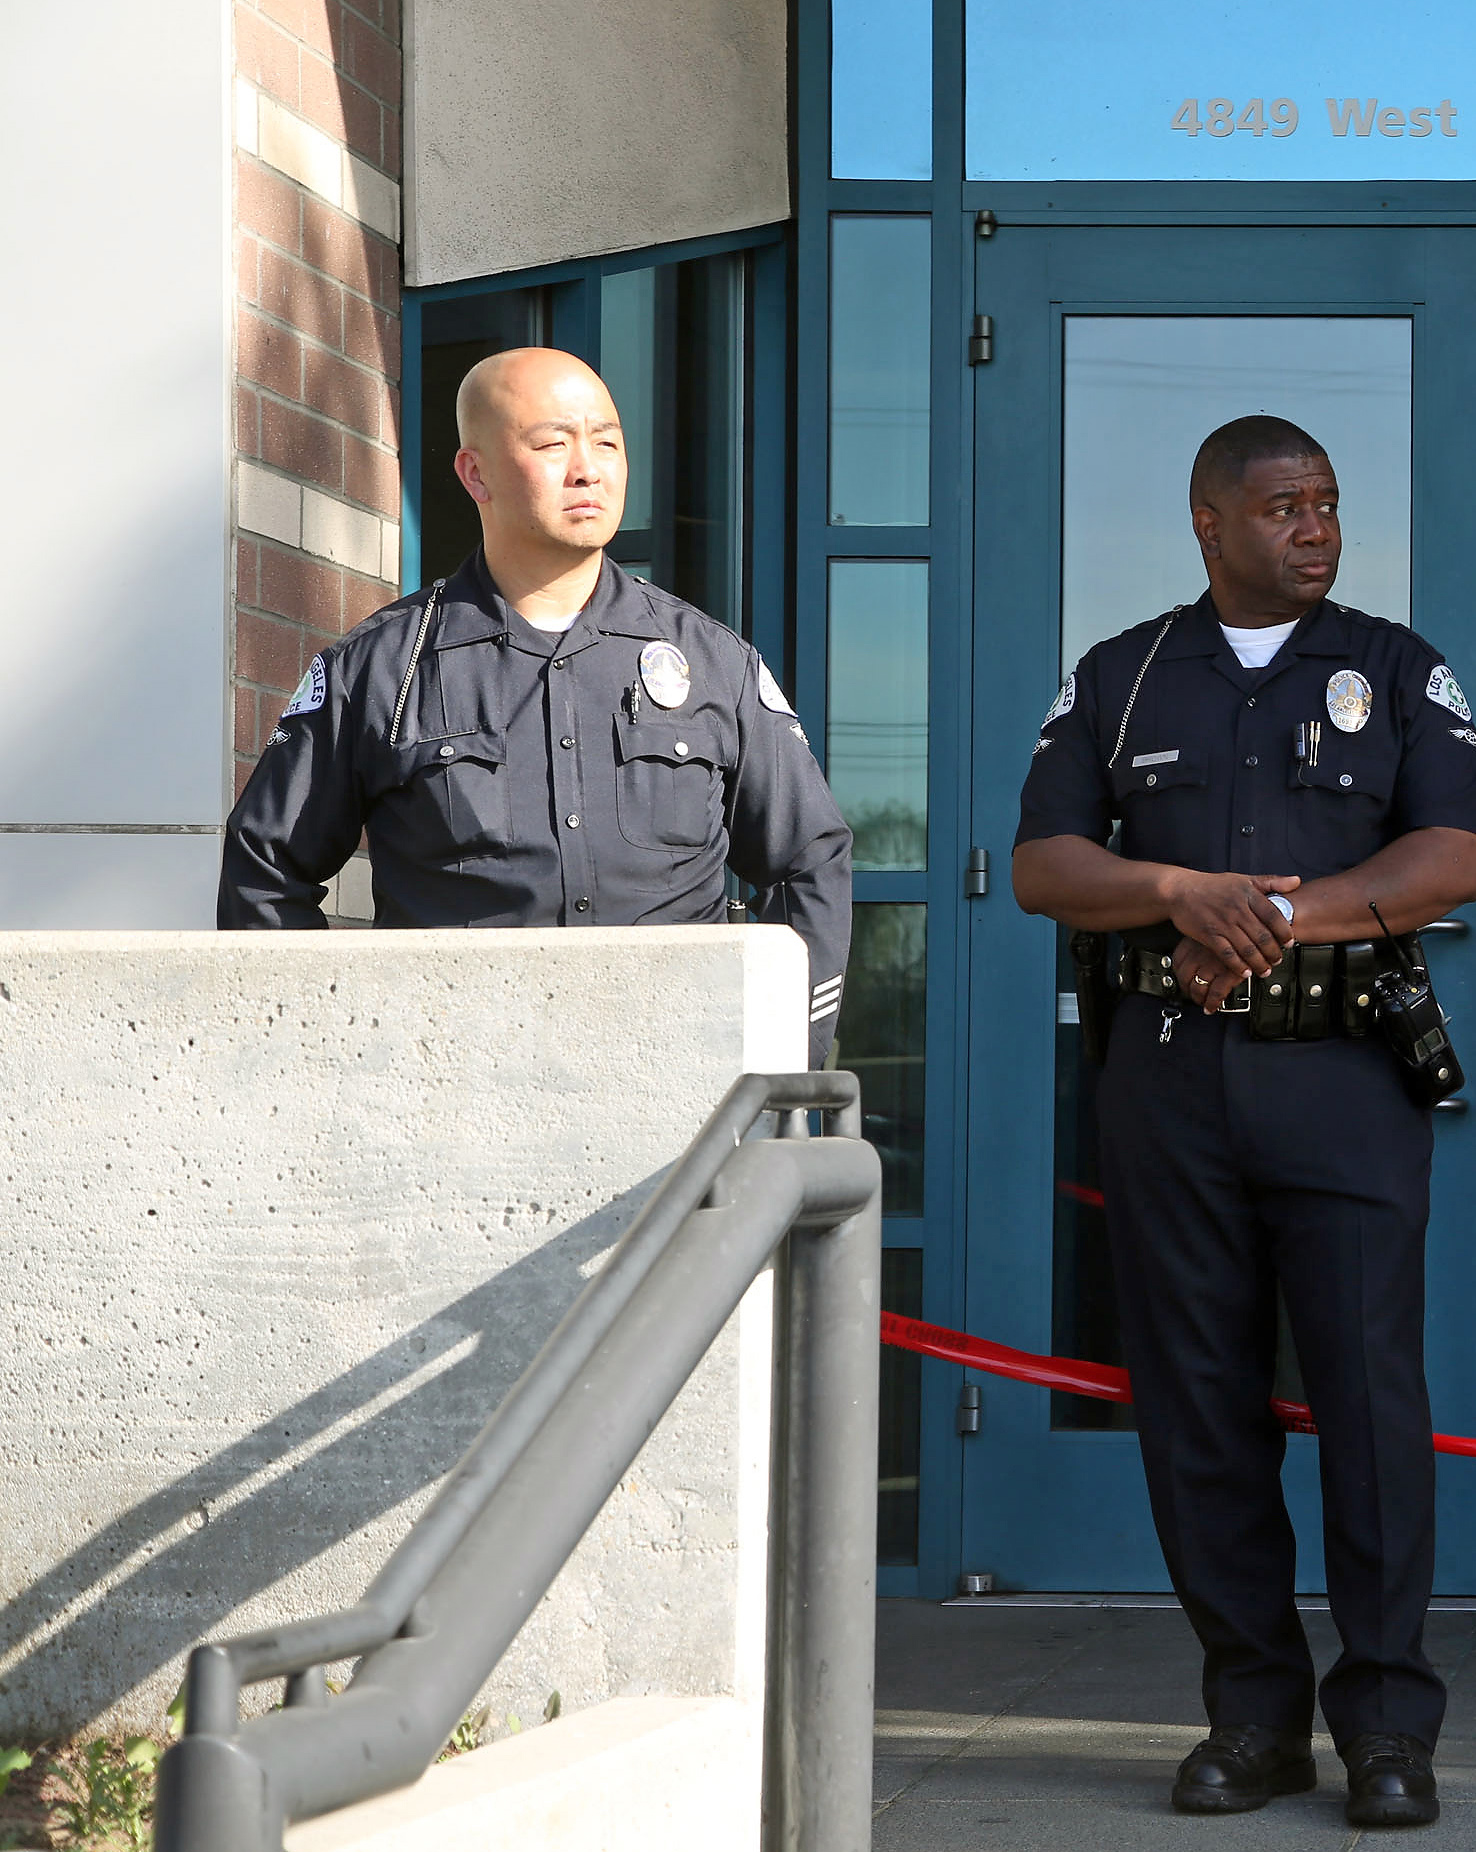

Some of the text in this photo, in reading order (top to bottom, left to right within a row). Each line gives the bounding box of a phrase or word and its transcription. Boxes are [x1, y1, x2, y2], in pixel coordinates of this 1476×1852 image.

[1169, 98, 1298, 138] 4849
[1325, 98, 1457, 138] West
[1429, 674, 1442, 696] LOS
